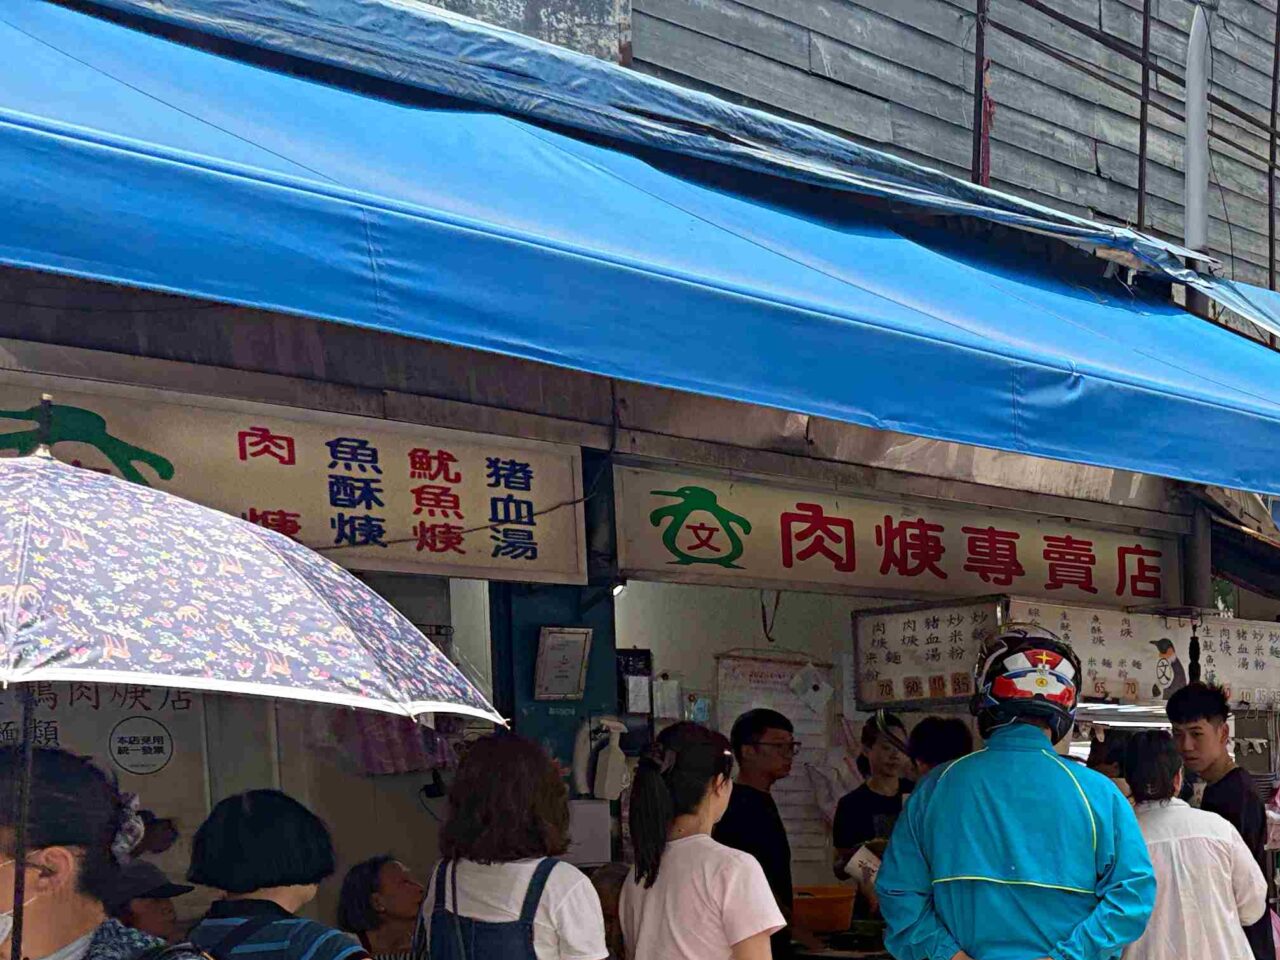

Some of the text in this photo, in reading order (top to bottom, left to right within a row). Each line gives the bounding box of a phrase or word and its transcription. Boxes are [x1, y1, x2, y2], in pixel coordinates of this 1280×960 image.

[685, 522, 721, 553] 文
[1126, 683, 1136, 694] 70
[117, 746, 165, 755] 統一發票
